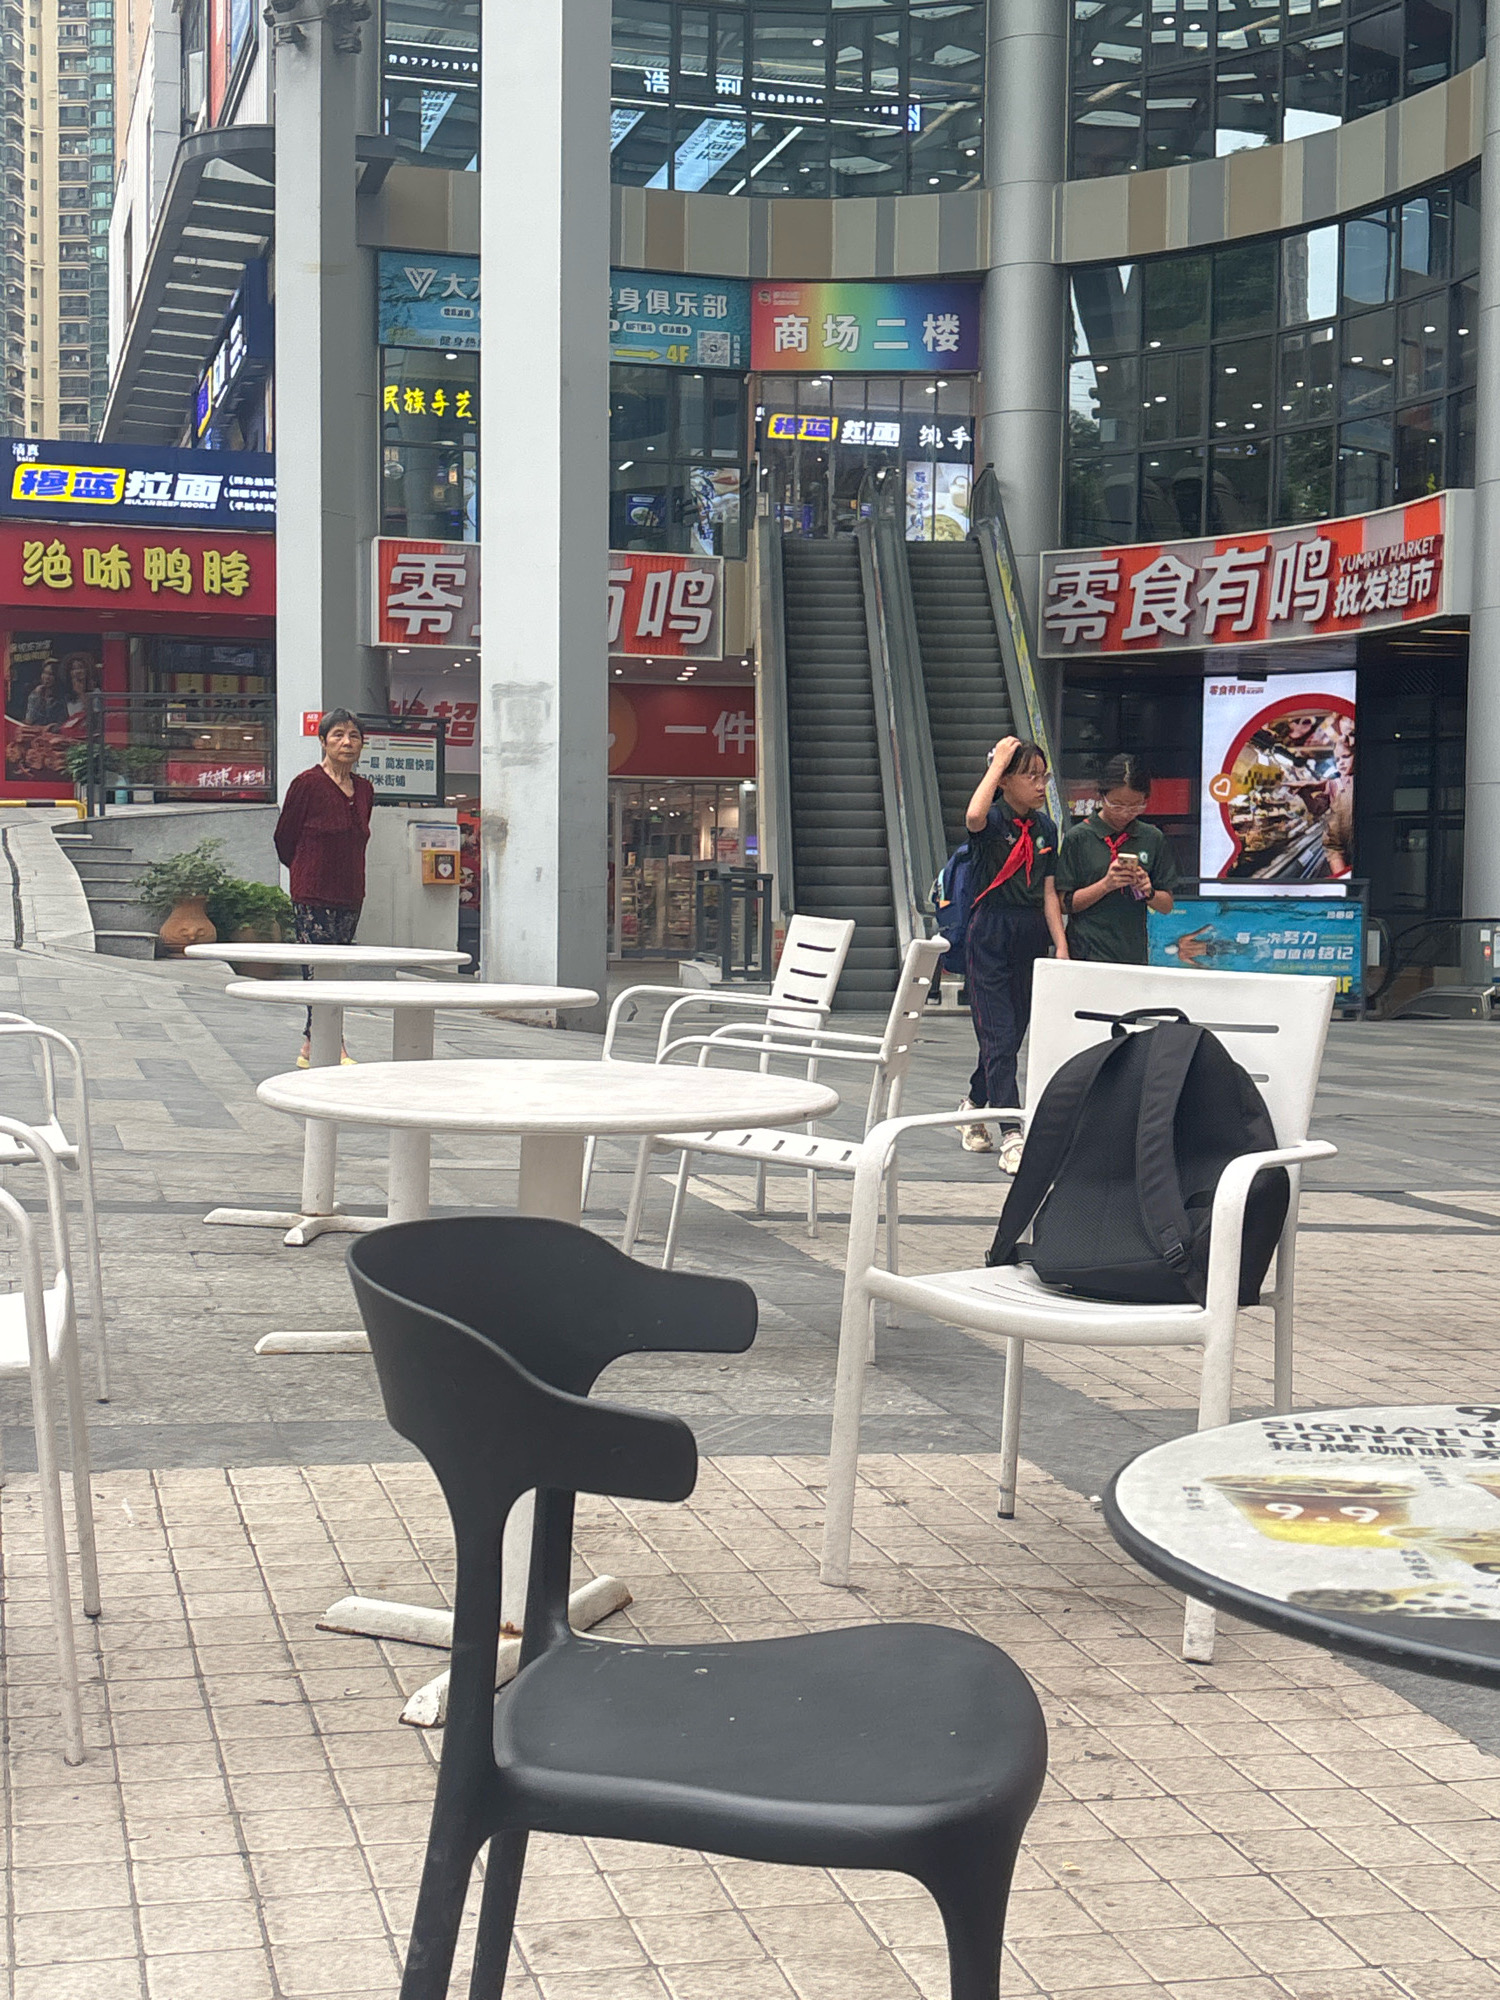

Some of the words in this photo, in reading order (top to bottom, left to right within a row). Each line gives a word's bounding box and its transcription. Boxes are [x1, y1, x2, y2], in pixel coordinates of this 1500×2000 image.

[441, 273, 481, 299] 大
[440, 335, 481, 348] 健身热
[772, 313, 961, 353] 商场二楼
[665, 345, 690, 364] 4F
[384, 384, 473, 418] 民族手艺
[12, 443, 40, 456] 清真
[22, 539, 251, 597] 绝味鸭脖
[1337, 547, 1388, 574] YUMMY
[1388, 536, 1436, 563] MARKET
[386, 553, 481, 637] 零
[1043, 536, 1333, 646] 零食有鸣
[1333, 558, 1435, 618] 批发超市
[664, 711, 756, 754] 一件
[1235, 930, 1318, 945] 每一次努力
[1265, 1431, 1467, 1448] COFFEE
[1265, 1502, 1381, 1523] 9.9
